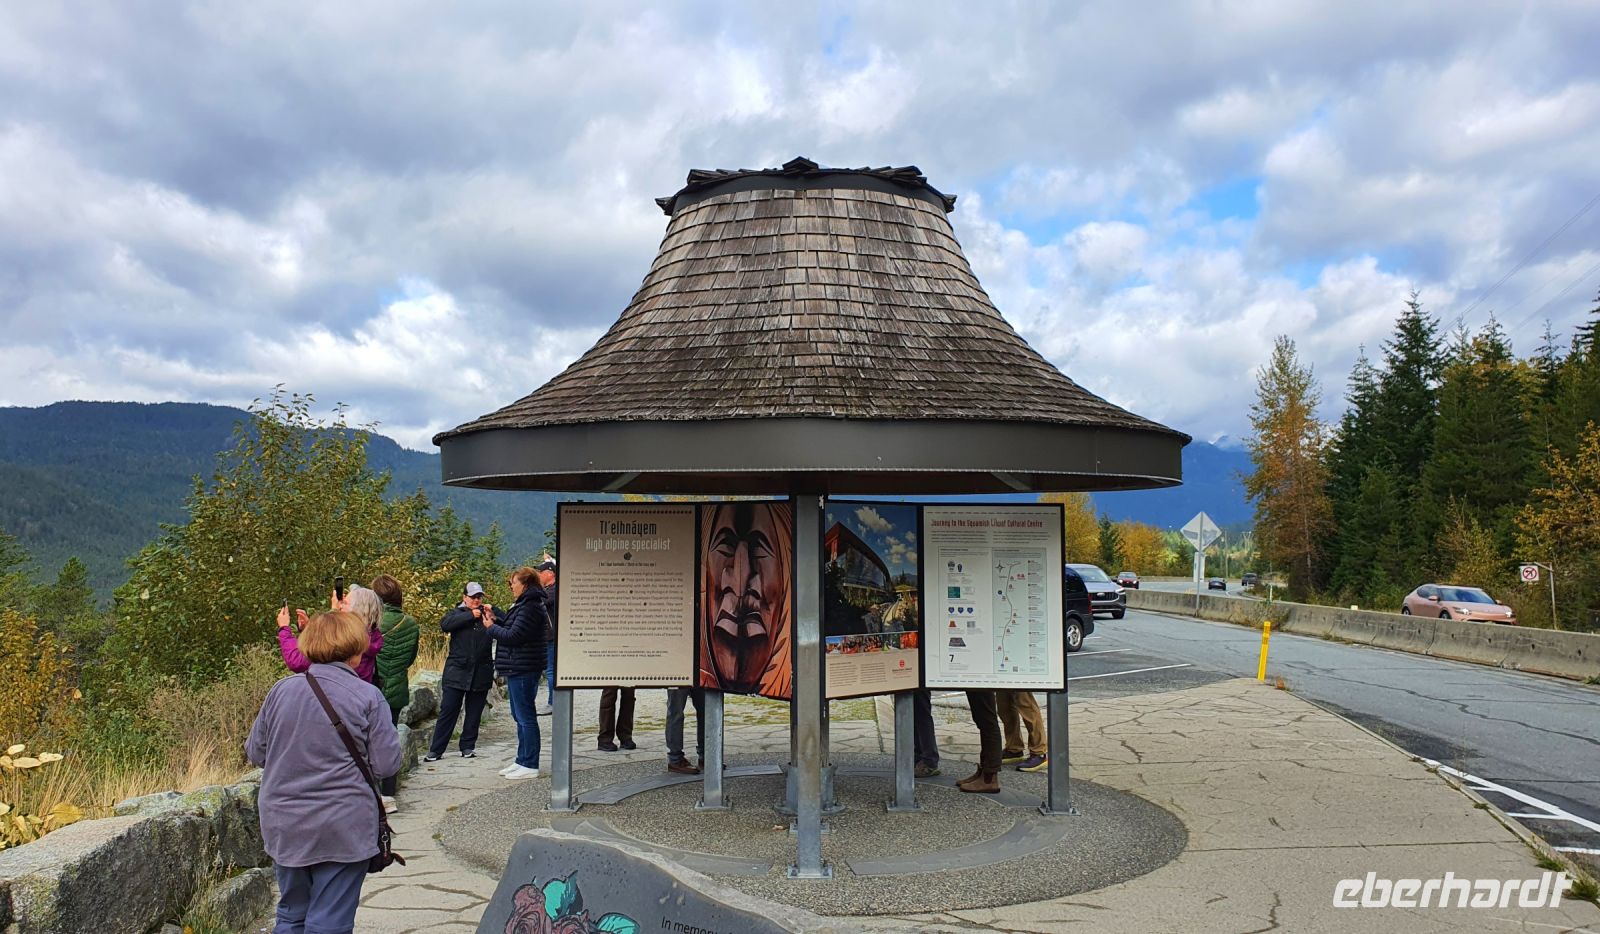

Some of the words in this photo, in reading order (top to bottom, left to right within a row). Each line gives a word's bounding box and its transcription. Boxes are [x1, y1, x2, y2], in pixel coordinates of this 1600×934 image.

[931, 519, 951, 528] Journey
[957, 519, 966, 527] the
[966, 519, 990, 528] Squamish
[1008, 519, 1027, 527] Cultural
[1027, 519, 1042, 527] Centre
[585, 537, 603, 552] High
[605, 537, 630, 552] alpine
[631, 537, 671, 552] specialist
[661, 916, 672, 930] In
[673, 922, 718, 934] memo
